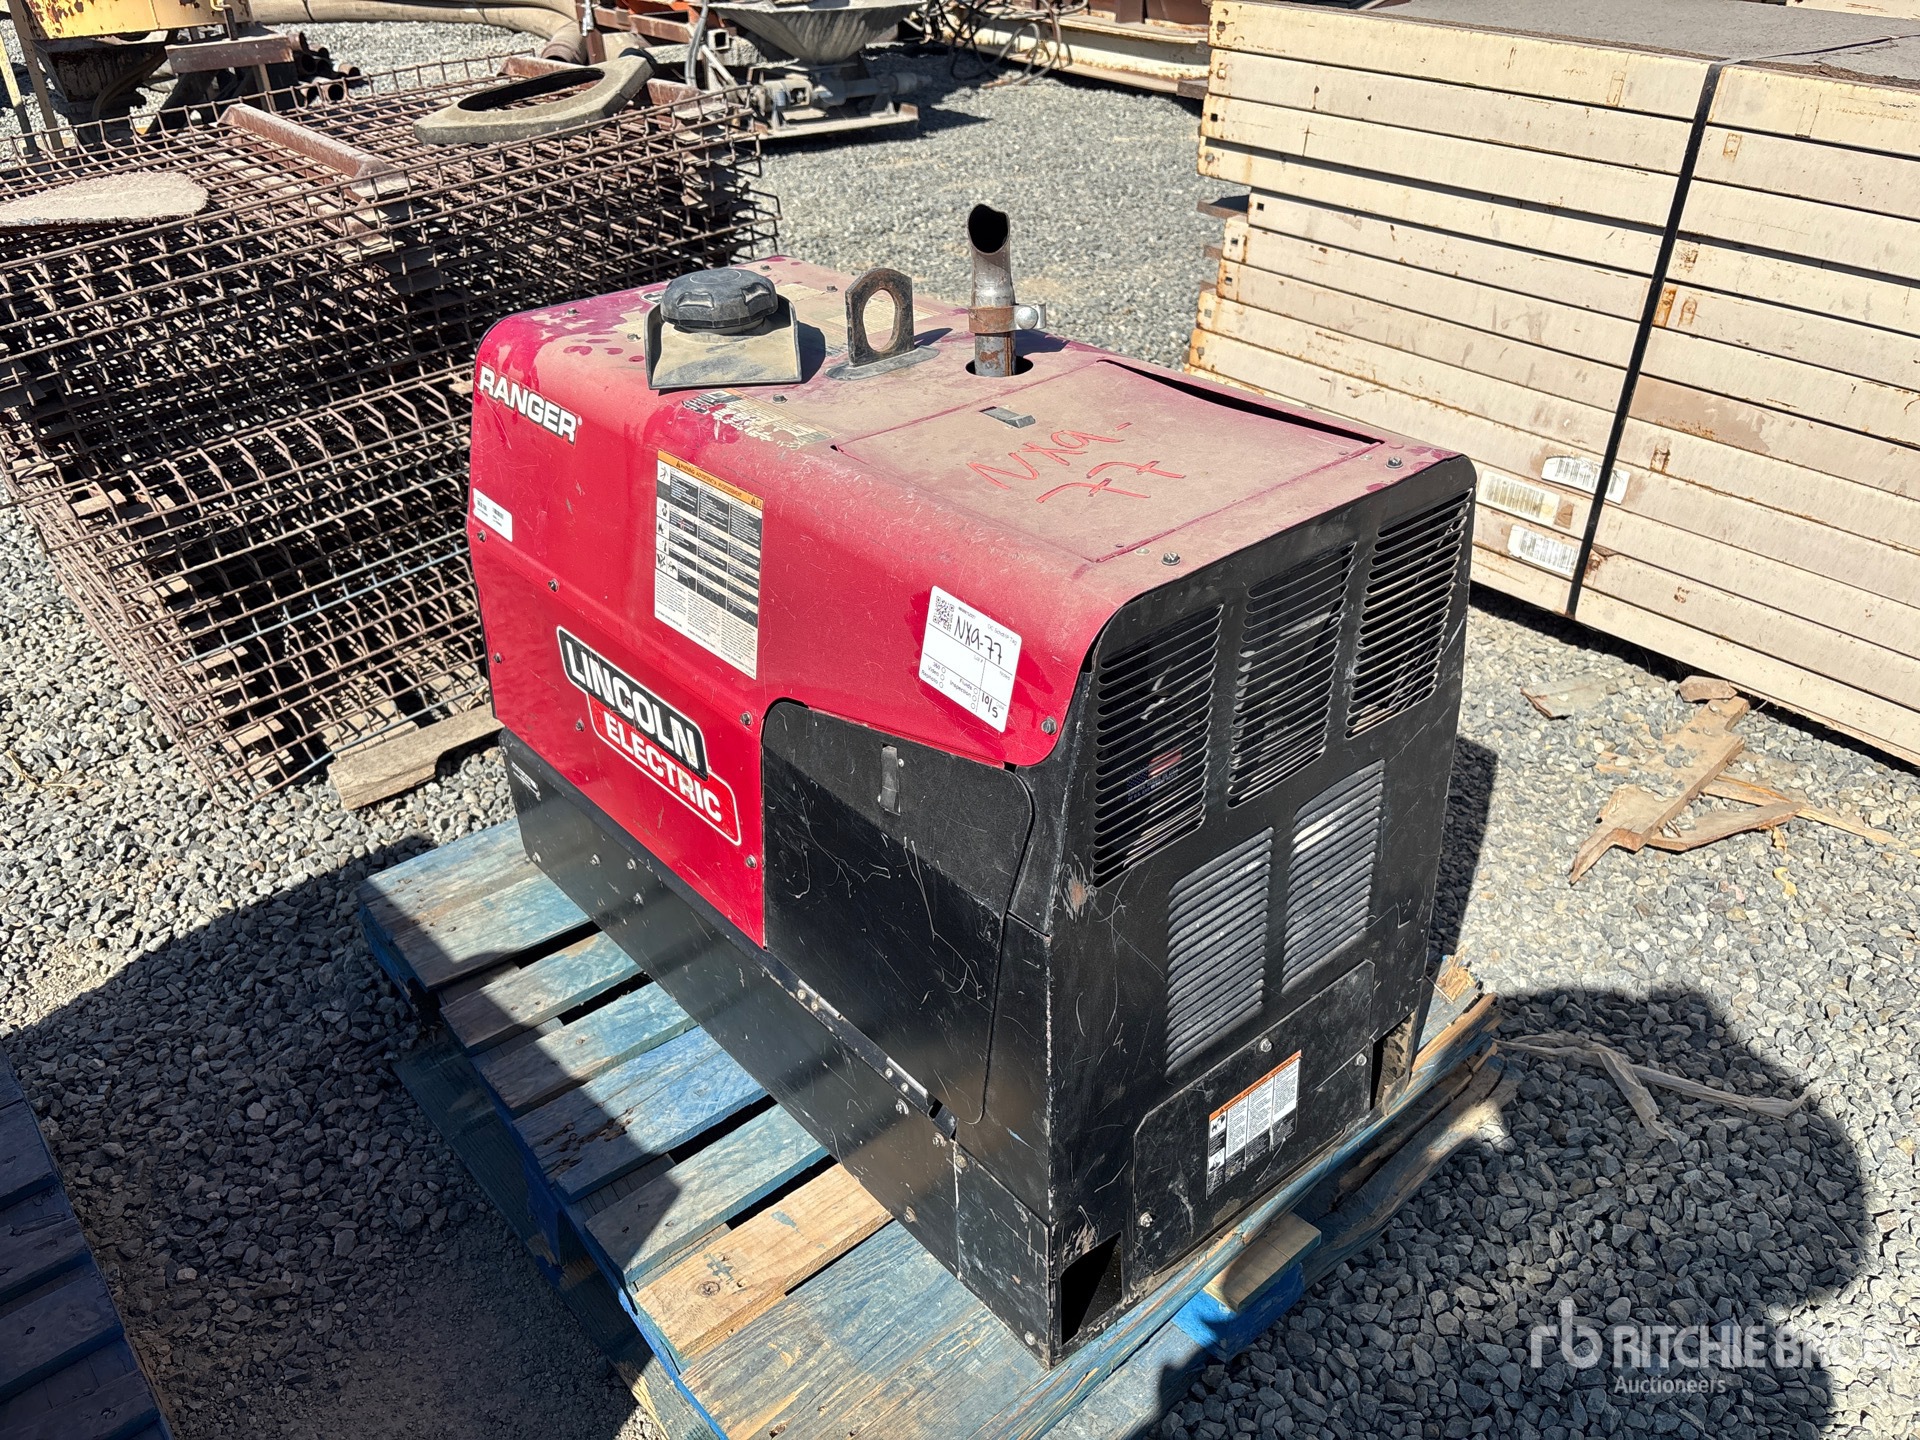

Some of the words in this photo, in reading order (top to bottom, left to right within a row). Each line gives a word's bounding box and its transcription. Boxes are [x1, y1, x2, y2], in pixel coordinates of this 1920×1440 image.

[479, 364, 578, 444] RANGER
[565, 640, 699, 770] LINCOLN
[603, 710, 723, 823] ELECTRIC
